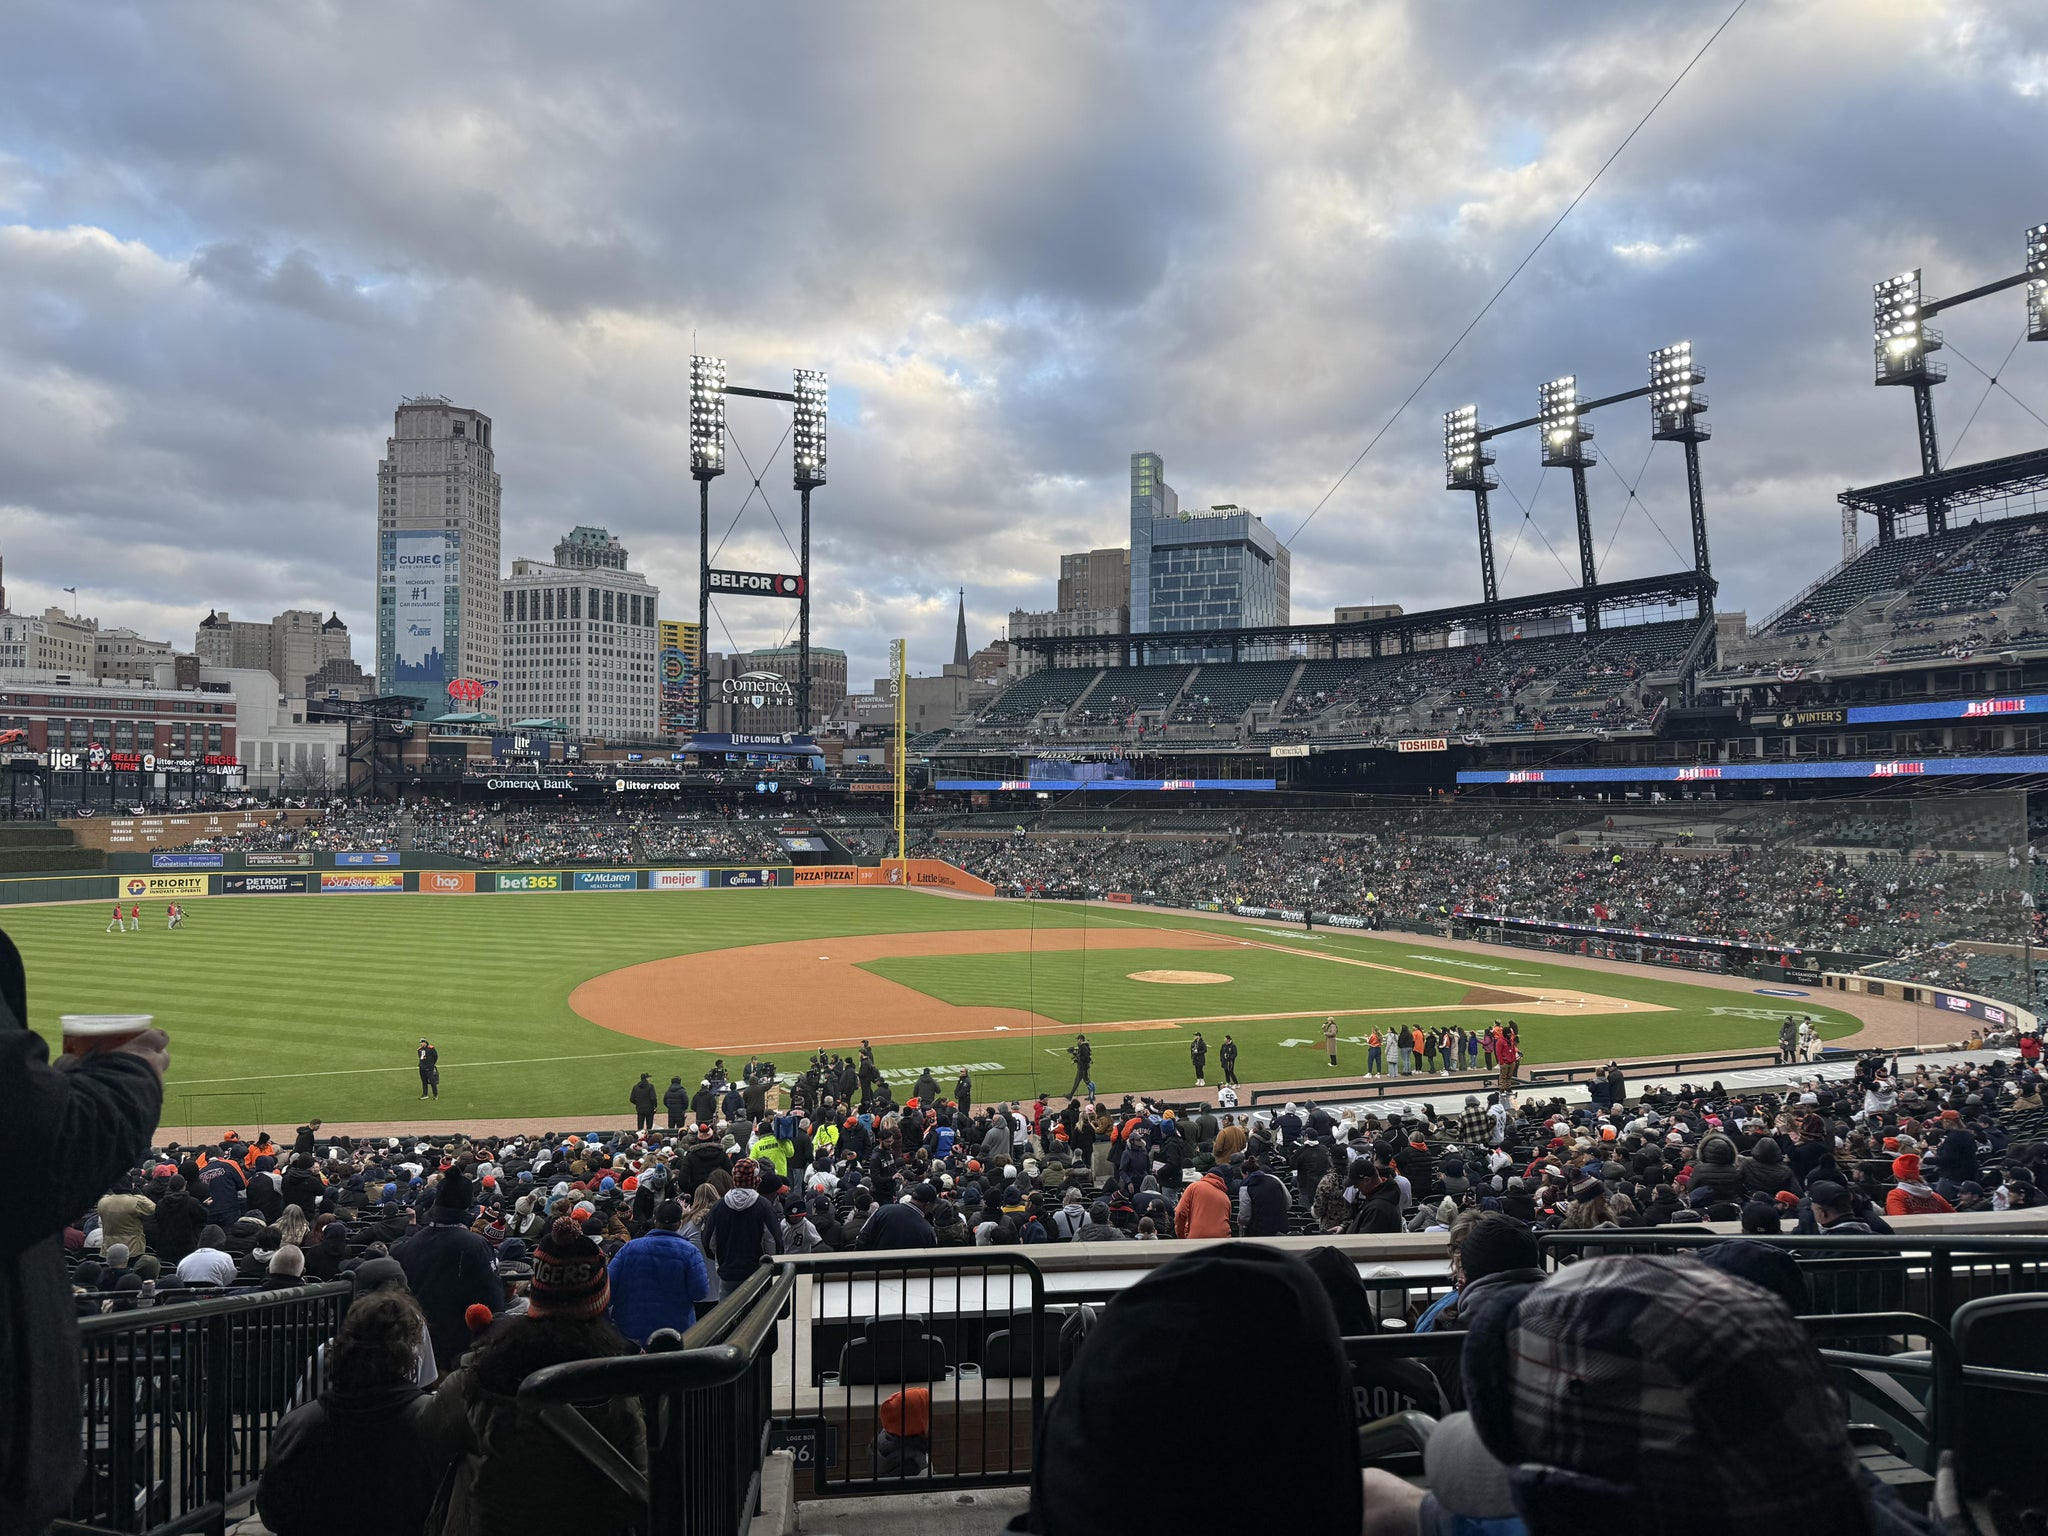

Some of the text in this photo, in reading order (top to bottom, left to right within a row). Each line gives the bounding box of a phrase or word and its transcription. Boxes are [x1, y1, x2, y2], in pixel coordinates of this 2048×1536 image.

[1190, 507, 1244, 520] Huntington
[400, 555, 431, 564] CURE
[710, 573, 771, 590] BELFOR
[412, 587, 428, 600] #1
[449, 681, 482, 697] AAA
[722, 695, 794, 709] LANDING
[1797, 711, 1842, 724] WINTER'S
[515, 736, 530, 749] Lite
[731, 733, 780, 745] Lite LOUNGE
[1400, 741, 1445, 751] TOSHIBA
[50, 749, 79, 770] ijer
[111, 753, 141, 762] BELLE
[204, 755, 237, 765] FIEGER
[1124, 751, 1144, 759] CLUB
[115, 763, 137, 771] TIRE
[216, 765, 237, 775] LAW
[543, 780, 573, 791] Bank
[209, 816, 219, 825] 10
[244, 813, 252, 822] 11
[594, 873, 631, 882] McLaren
[662, 873, 697, 886] meijer
[730, 876, 756, 885] Corona
[795, 871, 854, 881] PIZZA! PIZZA!
[917, 873, 938, 883] Little
[150, 879, 201, 888] PRIORITY
[246, 878, 288, 886] DETROIT
[328, 876, 372, 887] Surfside
[437, 878, 459, 888] hap
[500, 876, 557, 889] bet365
[1237, 906, 1267, 916] Dunham's
[1328, 915, 1364, 927] Dunham's
[879, 1062, 1006, 1079] WEEKEND
[759, 1142, 779, 1151] VENDOR
[533, 1257, 592, 1283] TIGERS
[1352, 1386, 1417, 1419] ROIT
